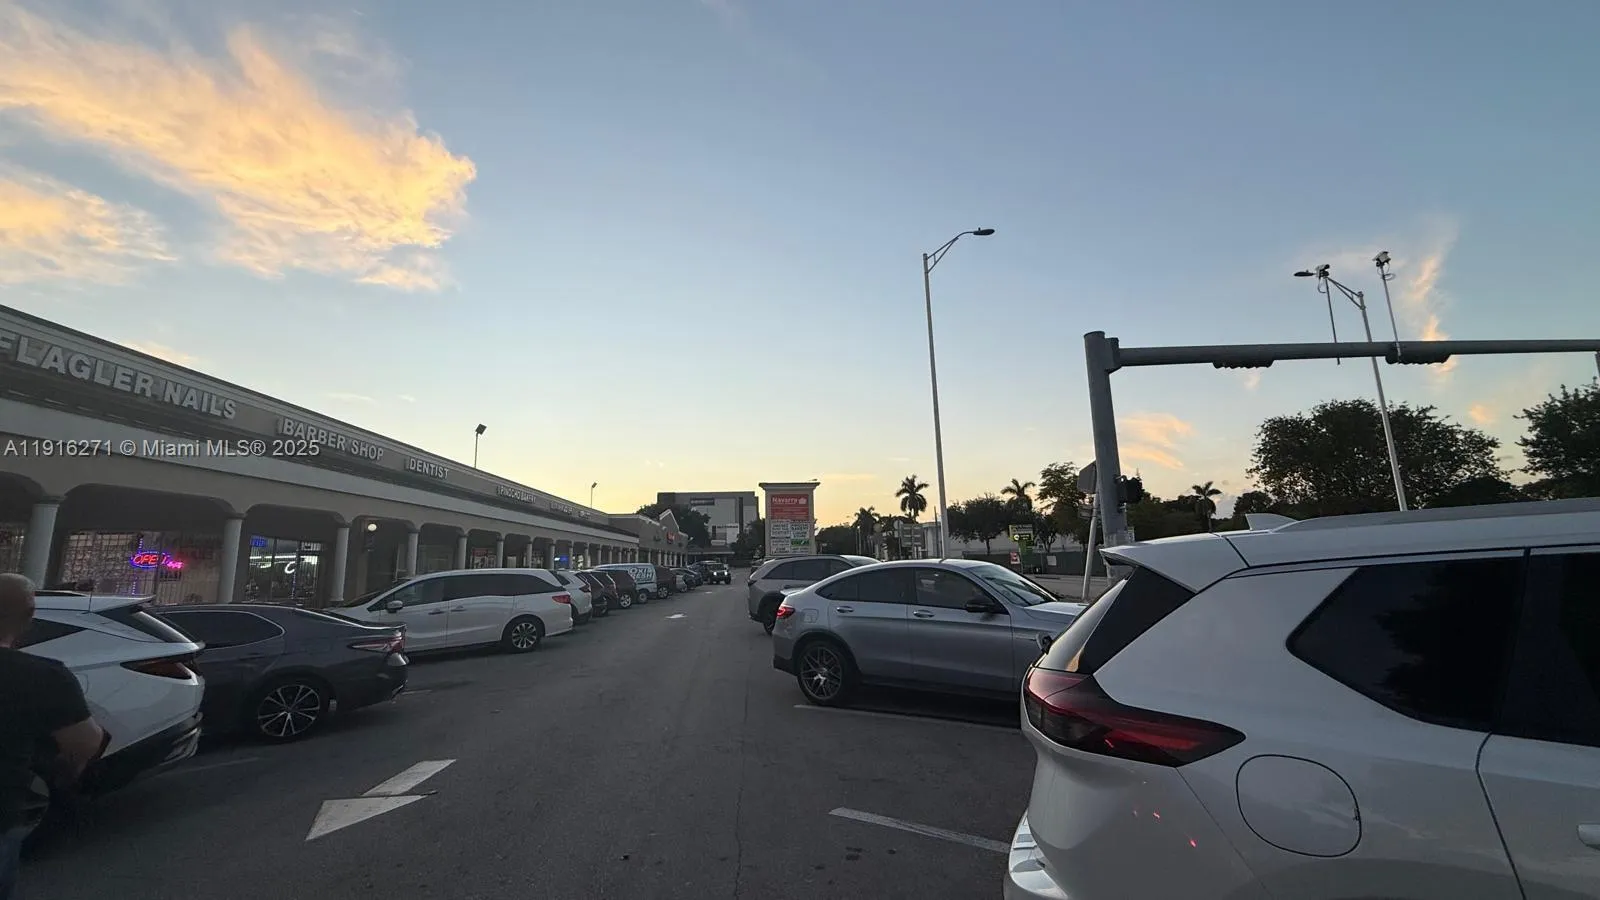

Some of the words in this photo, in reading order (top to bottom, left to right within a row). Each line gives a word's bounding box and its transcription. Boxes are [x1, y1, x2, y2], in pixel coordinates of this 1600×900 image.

[0, 329, 154, 398] FLAGLER
[162, 379, 237, 420] NAILS
[280, 418, 346, 451] BARBER
[351, 439, 384, 461] SHOP
[408, 457, 449, 480] DENTIST
